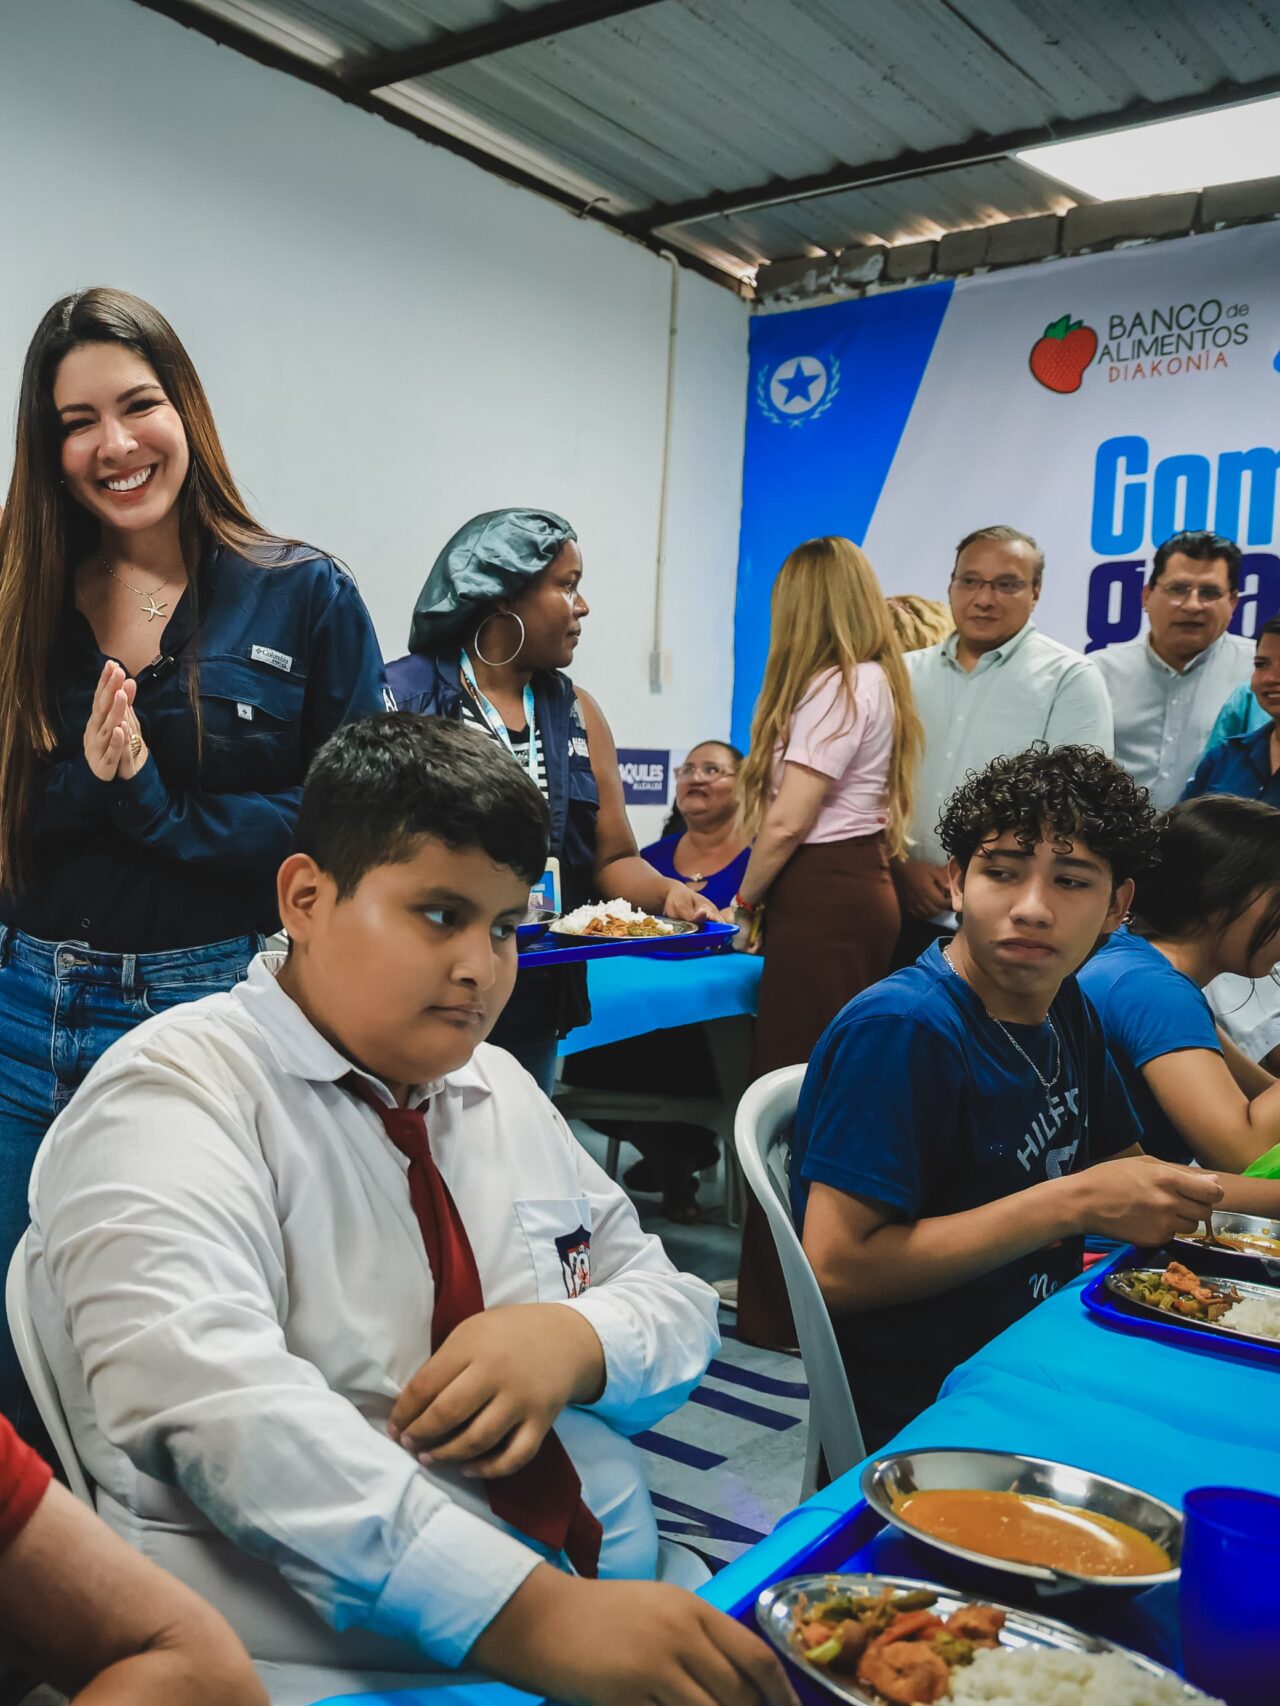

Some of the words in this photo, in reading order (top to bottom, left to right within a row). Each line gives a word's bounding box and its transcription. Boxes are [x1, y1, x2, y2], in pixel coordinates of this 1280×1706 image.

[1108, 299, 1223, 340] BANCO
[1226, 302, 1251, 319] de
[1097, 323, 1250, 364] ALIMENTOS
[262, 648, 289, 665] Columbia
